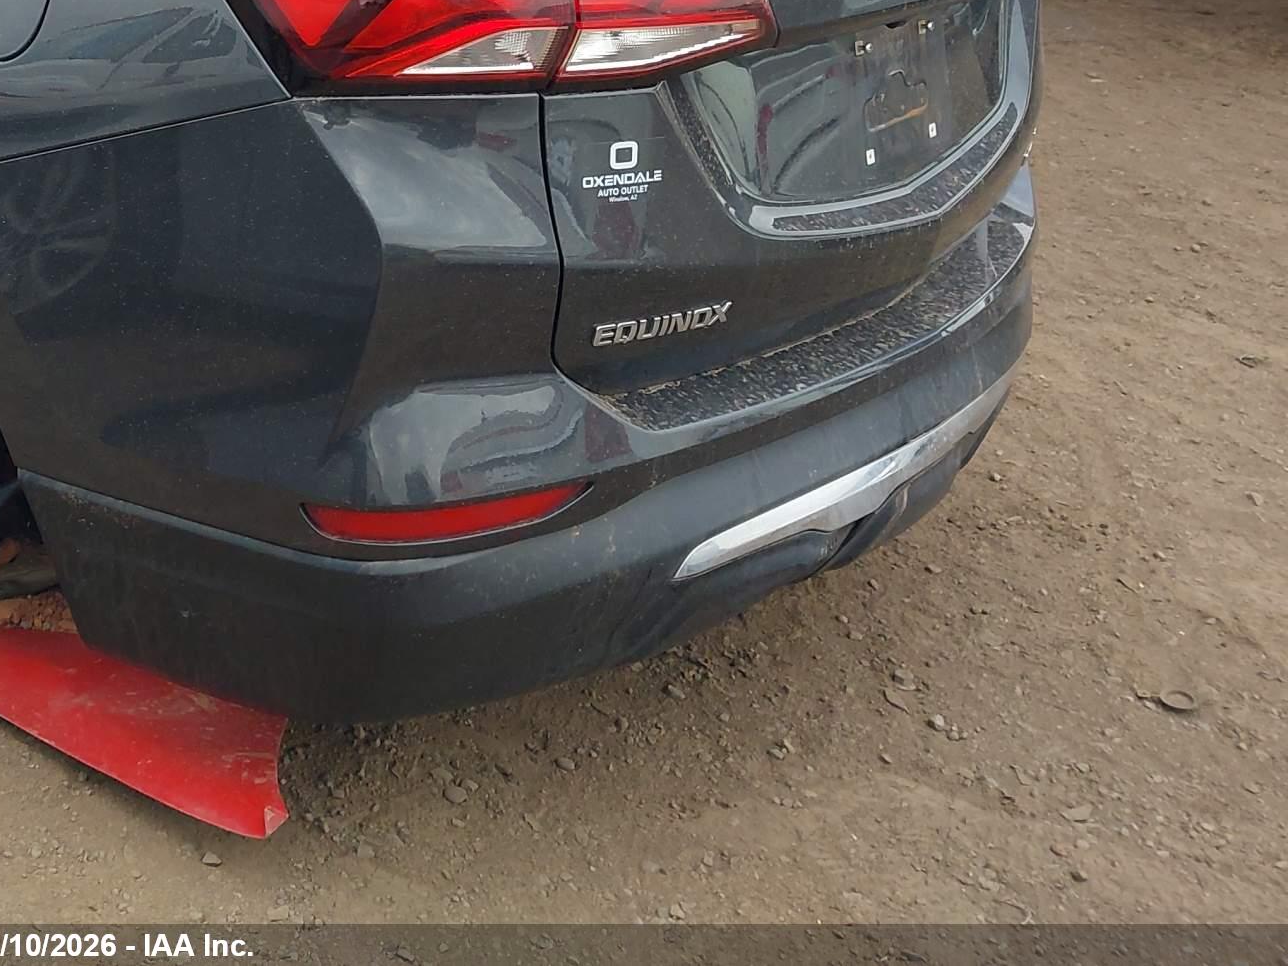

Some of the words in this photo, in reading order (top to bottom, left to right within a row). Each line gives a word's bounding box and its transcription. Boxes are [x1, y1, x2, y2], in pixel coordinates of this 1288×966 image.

[582, 170, 663, 188] OXENDALE
[597, 188, 620, 198] AUTO
[620, 184, 649, 195] OUTLET
[593, 301, 732, 347] EQUINOX
